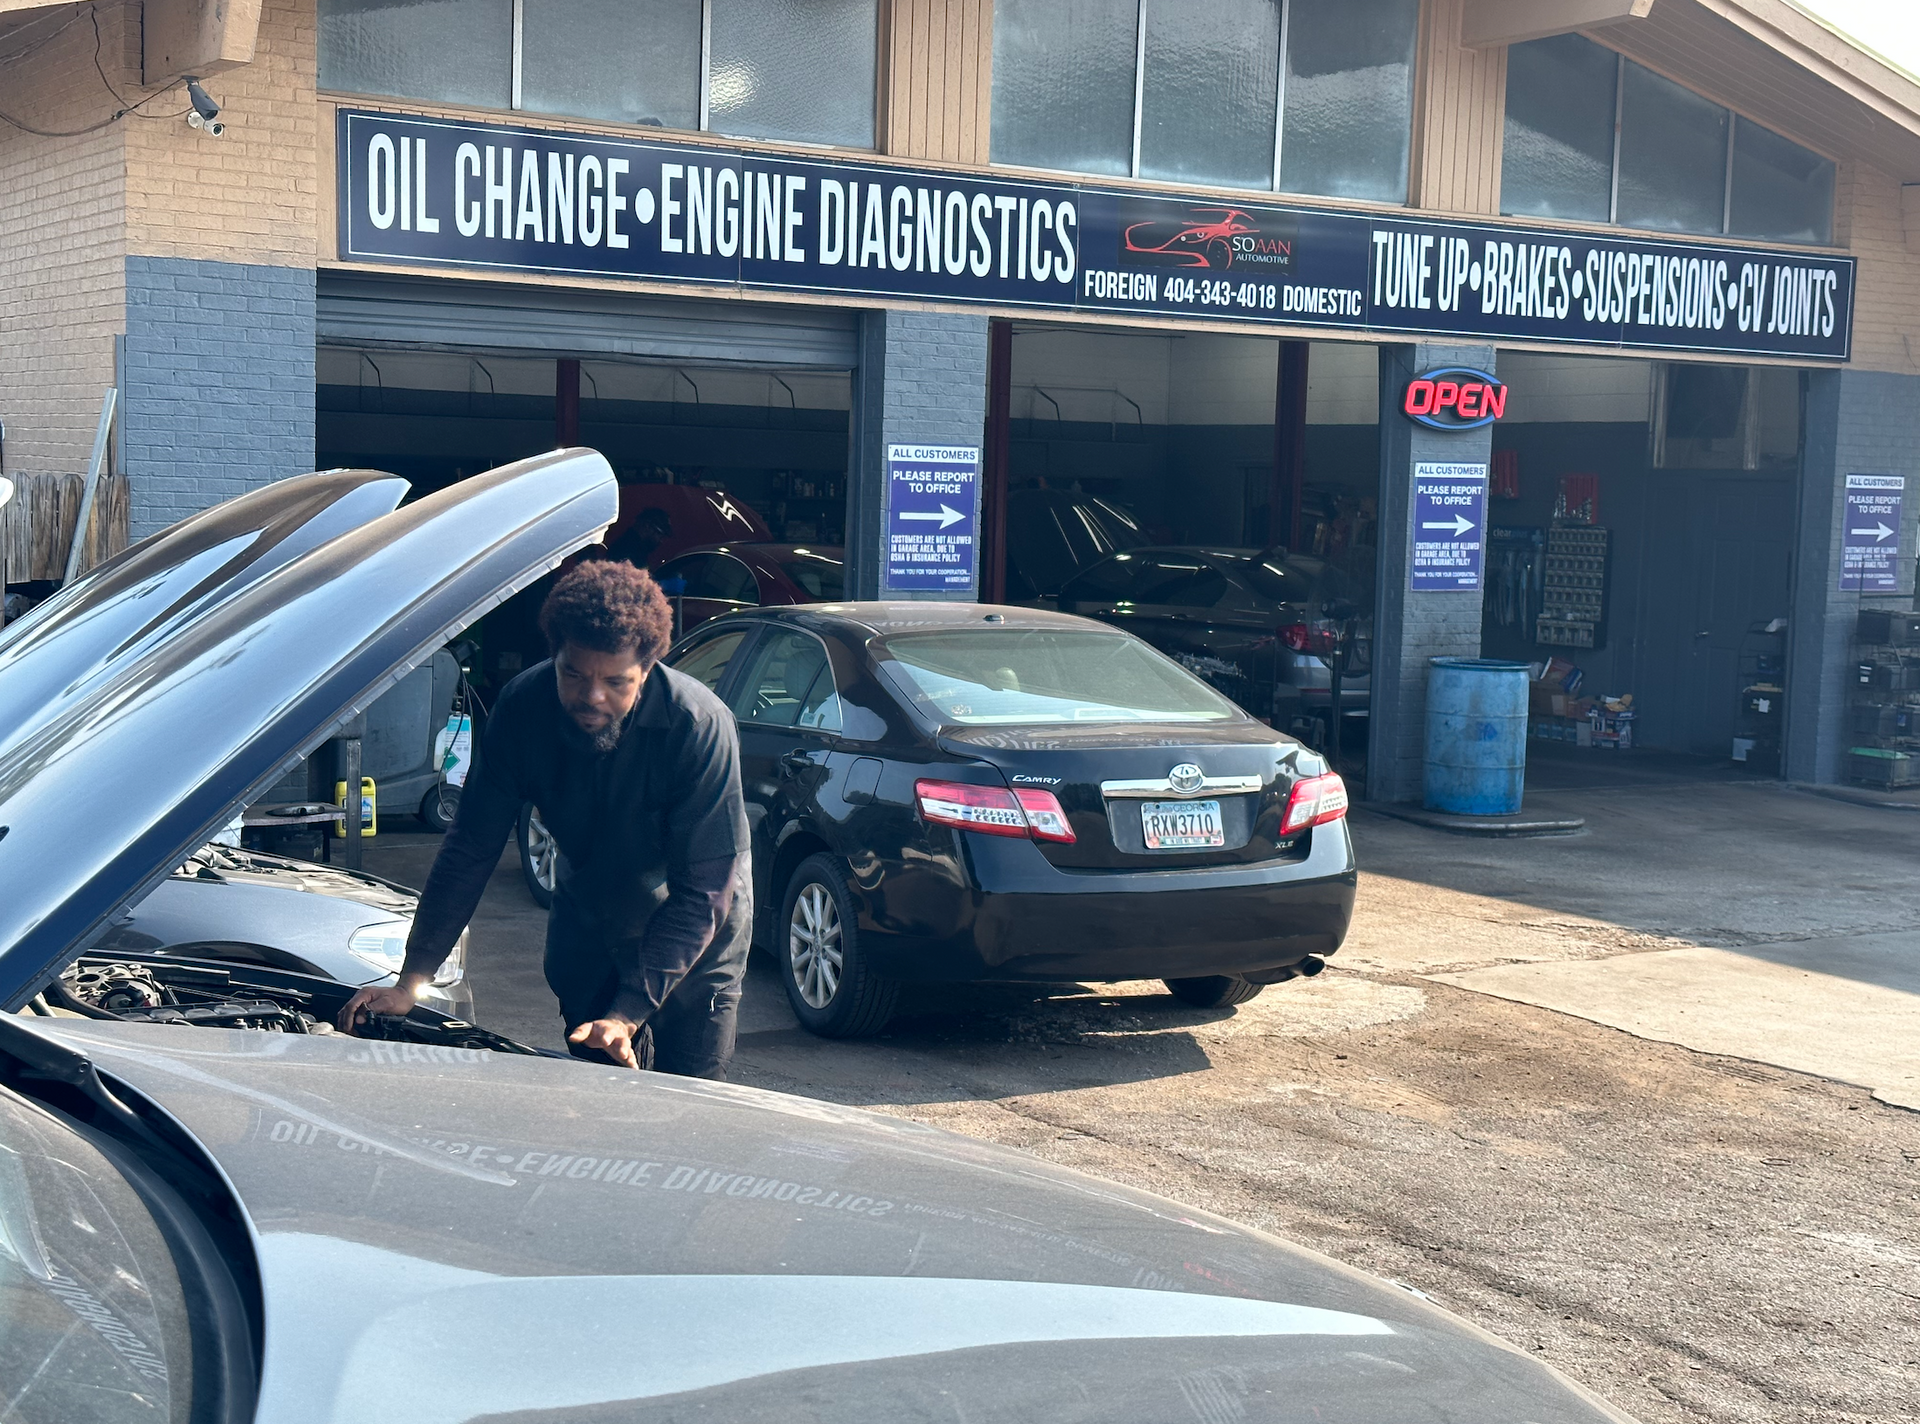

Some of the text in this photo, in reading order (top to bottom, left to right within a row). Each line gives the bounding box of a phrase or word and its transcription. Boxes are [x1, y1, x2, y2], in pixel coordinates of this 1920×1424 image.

[368, 132, 1077, 284] OIL CHANGE ENGINE DIAGNOSTICS
[1232, 236, 1291, 256] SOAAN
[1236, 253, 1290, 265] AUTOMOTIVE
[1372, 231, 1837, 338] TUNE UP BRAKES SUSPENSIONS CV JOINTS
[1084, 270, 1362, 316] FOREIGN 404-343-4018 DOMESTIC
[1404, 380, 1508, 419] OPEN
[893, 448, 976, 460] ALL CUSTOMERS
[893, 470, 975, 482] PLEASE REPORT
[1418, 466, 1484, 476] ALL CUSTOMERS
[1849, 477, 1902, 487] ALL CUSTOMERS
[909, 483, 961, 494] TO OFFICE
[1417, 485, 1483, 495] PLEASE REPORT
[1430, 496, 1473, 506] TO OFFICE
[1848, 495, 1901, 505] PLEASE REPORT
[1858, 505, 1892, 514] TO OFFICE
[891, 534, 972, 545] CUSTOMERS ARE NOT ALLOWED
[942, 554, 961, 563] POLICY
[1011, 774, 1062, 785] CAMRY
[1172, 803, 1215, 812] GEORGIA
[1151, 813, 1214, 837] RXW3710
